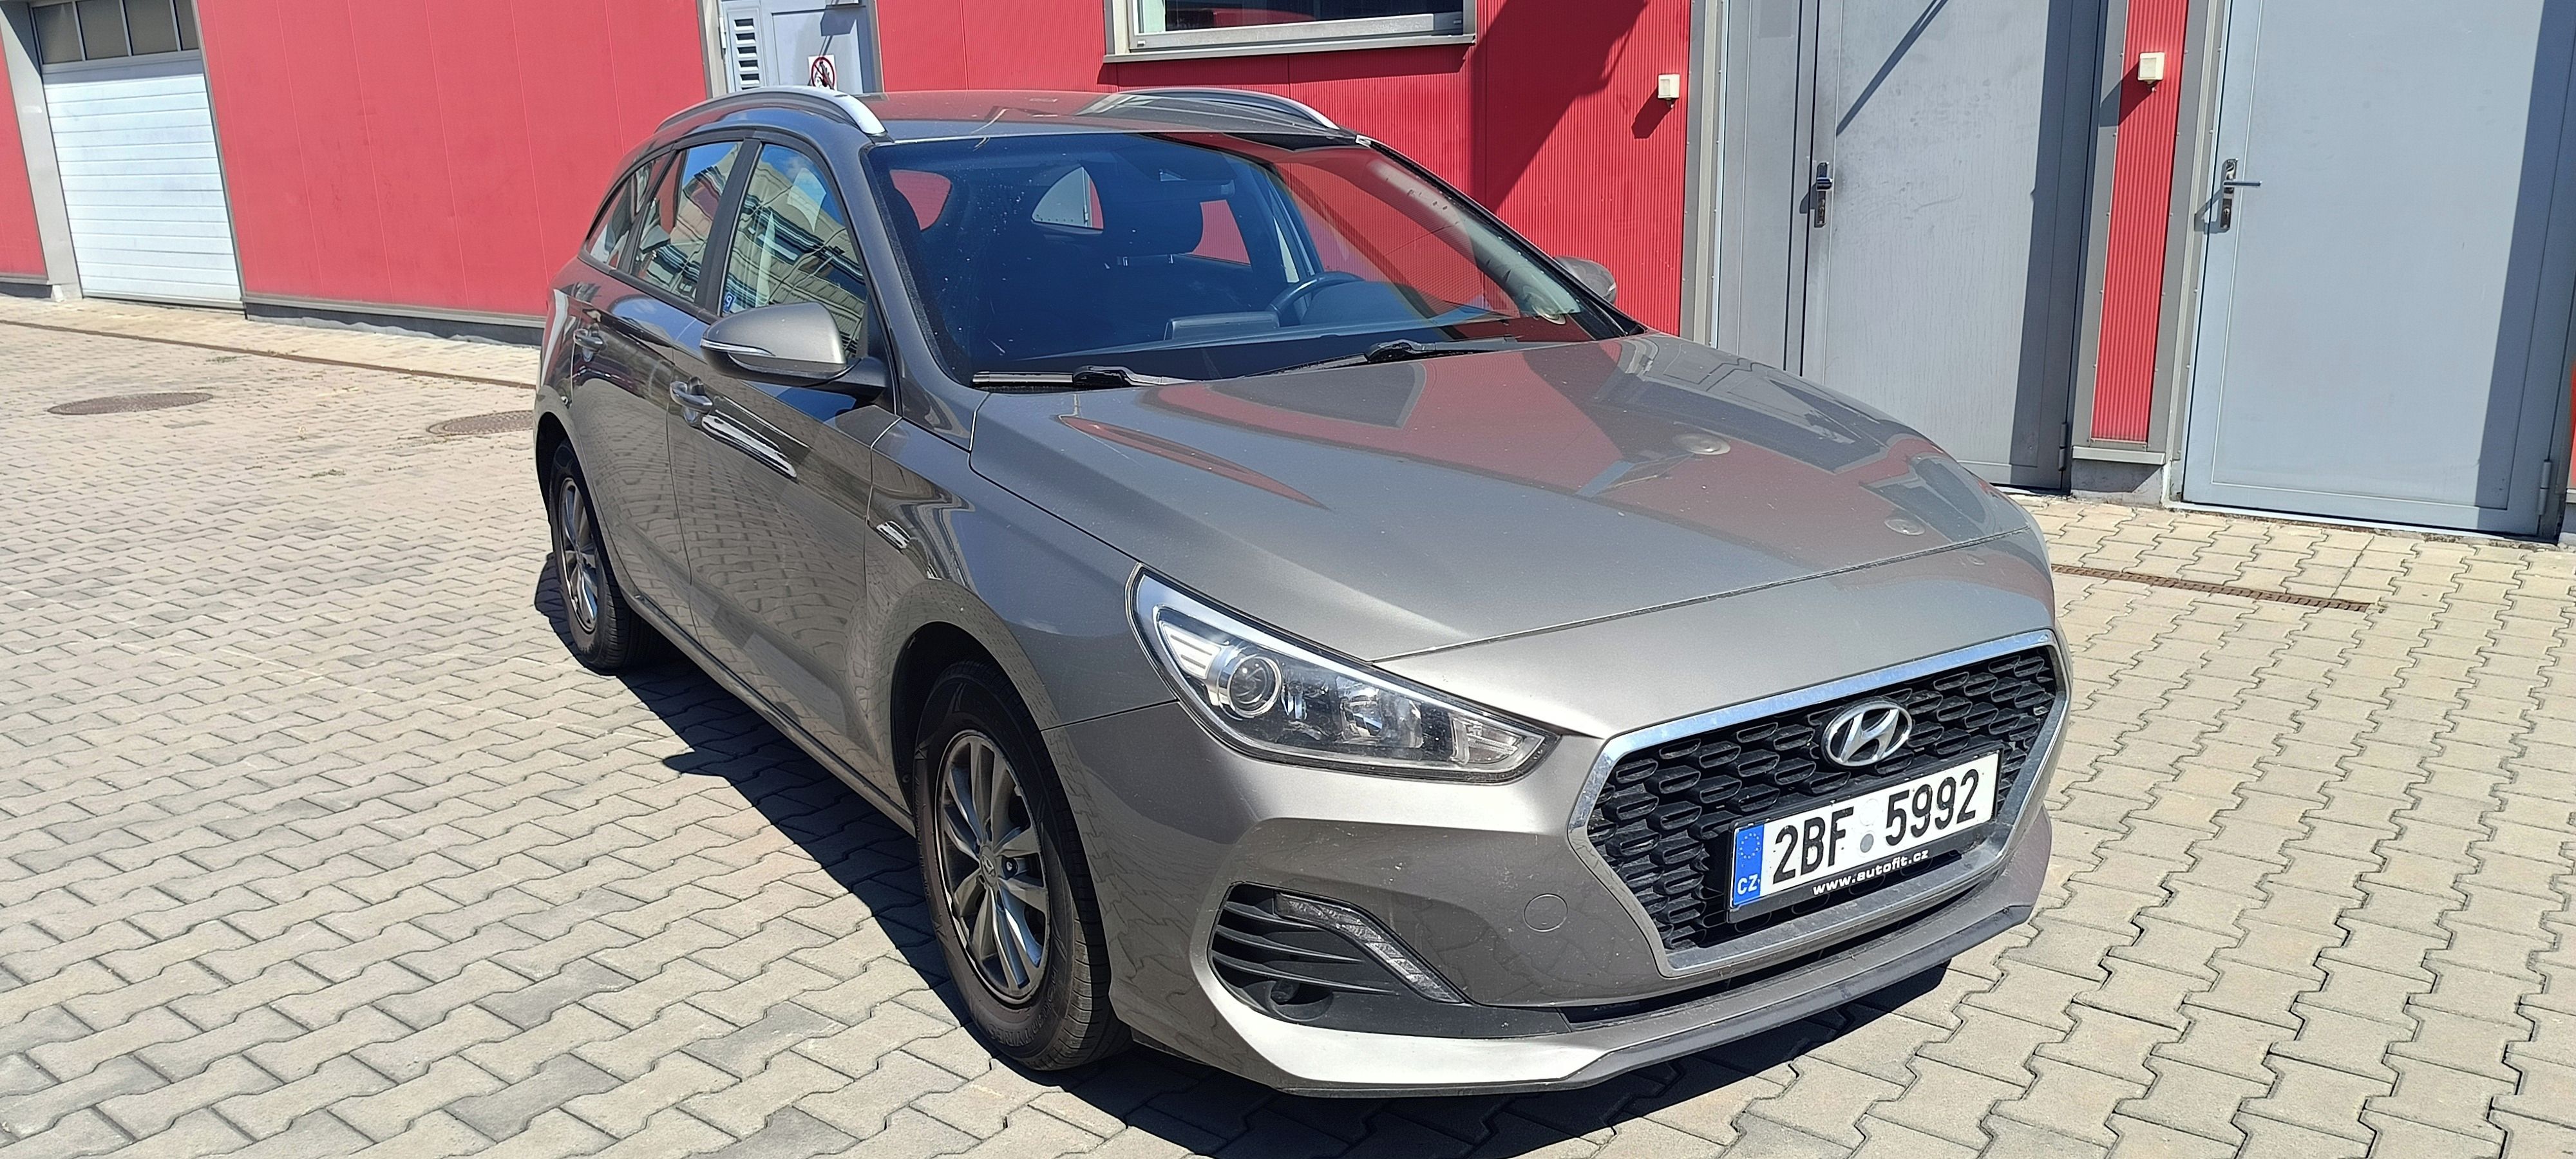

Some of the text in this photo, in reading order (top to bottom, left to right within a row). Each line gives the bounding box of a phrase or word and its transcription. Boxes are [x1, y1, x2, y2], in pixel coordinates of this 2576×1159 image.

[1772, 768, 1979, 885] 2BF 5992
[1738, 875, 1757, 896] CZ
[1812, 849, 1929, 896] www.autofit.cz
